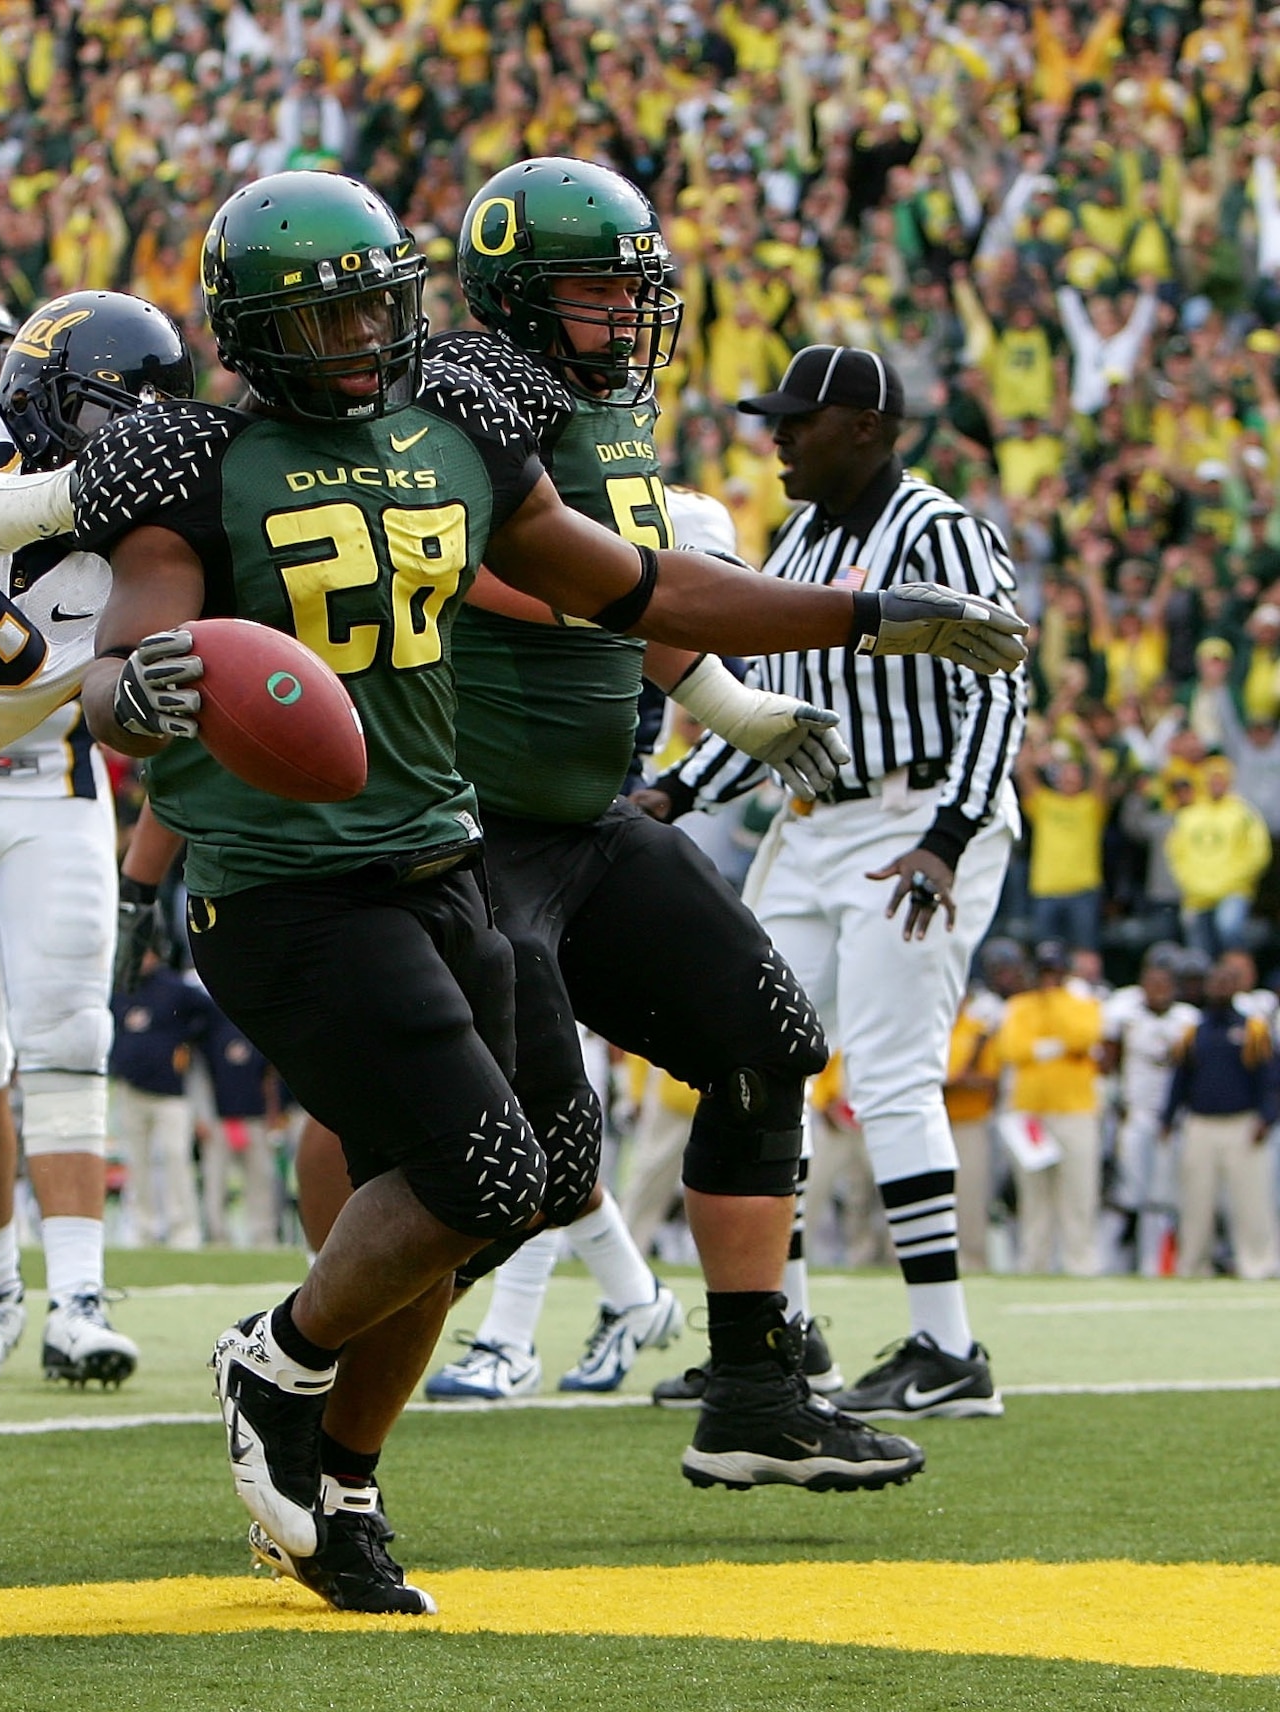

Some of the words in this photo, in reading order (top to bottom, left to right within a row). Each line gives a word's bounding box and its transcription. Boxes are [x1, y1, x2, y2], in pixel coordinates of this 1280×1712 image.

[471, 197, 518, 257] O
[340, 252, 362, 272] O
[595, 440, 654, 463] DUCKS
[285, 467, 438, 493] DUCKS
[262, 500, 468, 676] 28
[265, 670, 302, 706] O
